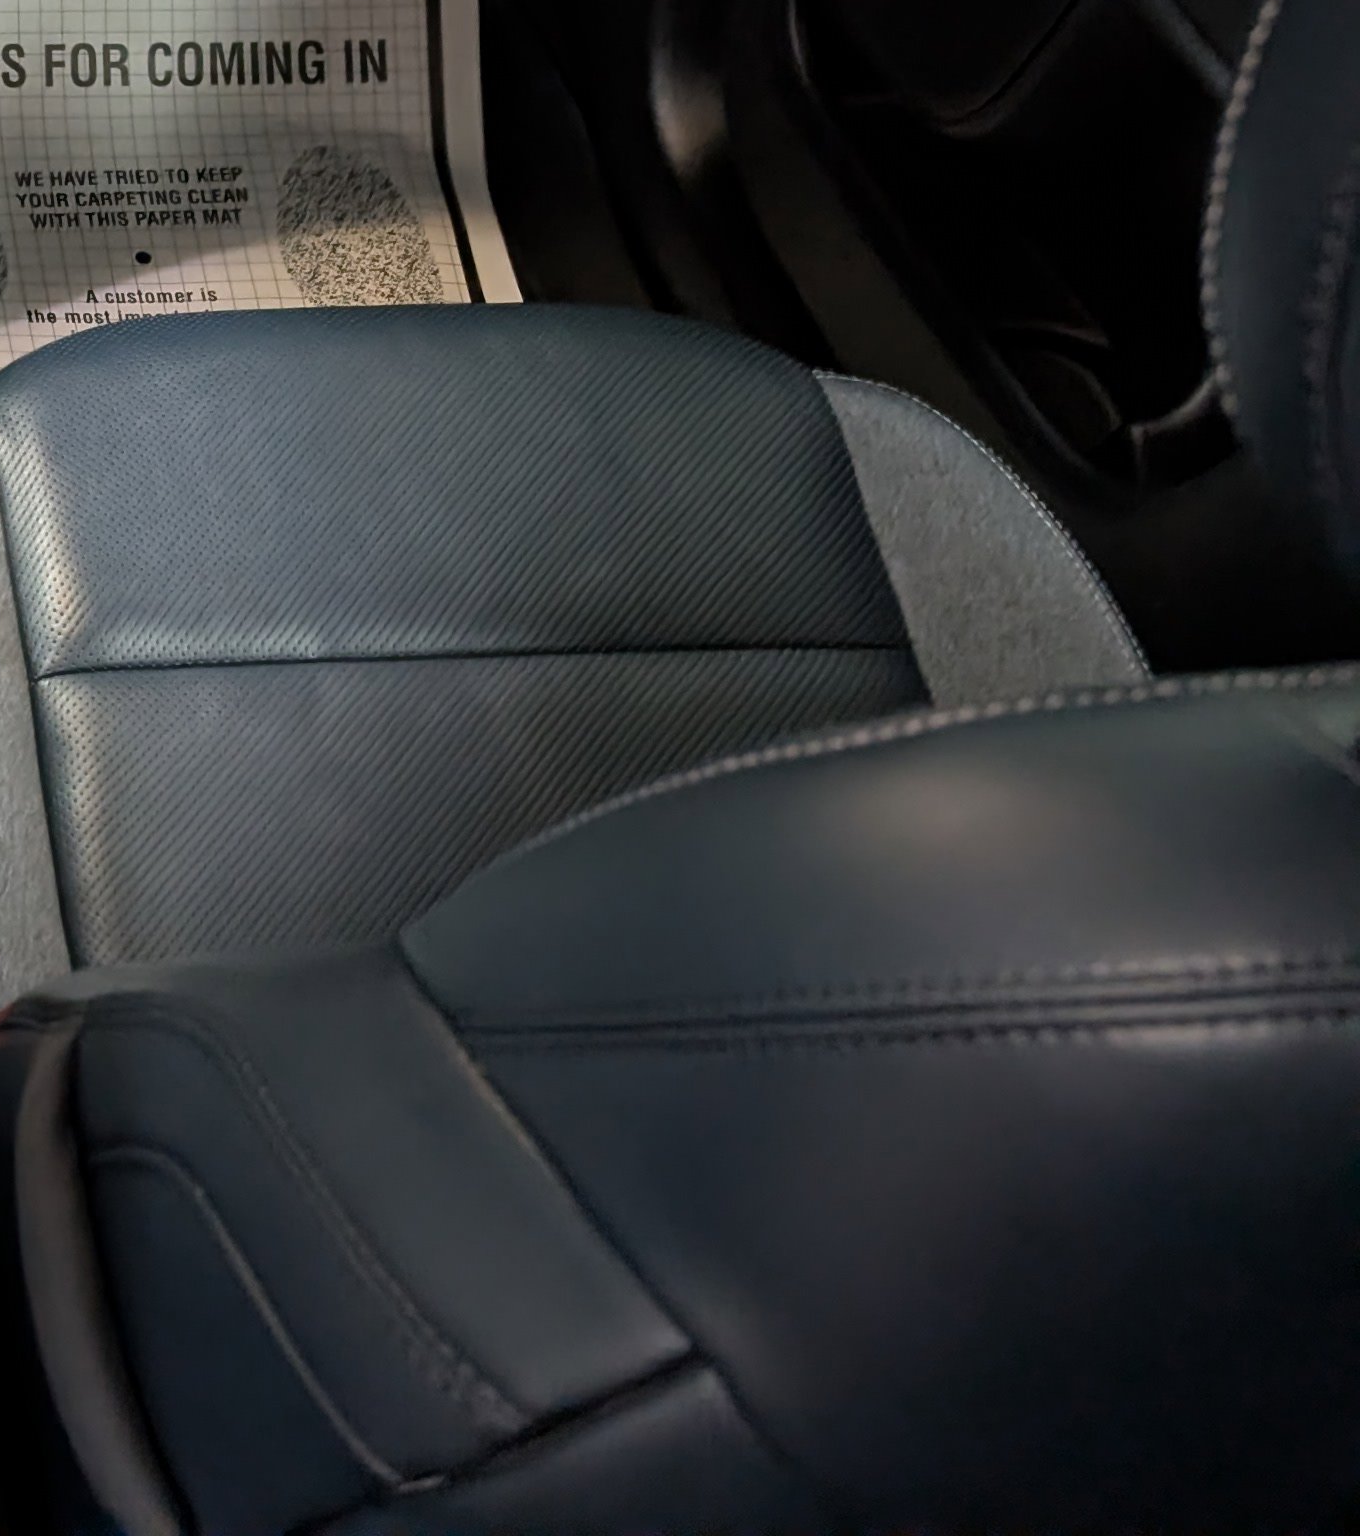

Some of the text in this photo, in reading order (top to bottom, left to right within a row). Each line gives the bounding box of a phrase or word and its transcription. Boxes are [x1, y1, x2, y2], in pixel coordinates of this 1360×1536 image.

[44, 43, 131, 87] FOR
[148, 40, 326, 86] COMING
[344, 38, 389, 83] IN
[15, 167, 242, 187] WE HAVE TRIED TO KEEP
[16, 187, 248, 208] YOUR CARPETING CLEAN
[30, 208, 242, 229] WITH THIS PAPER MAT
[86, 287, 218, 304] A customer is
[26, 309, 57, 324] the
[65, 310, 110, 324] most
